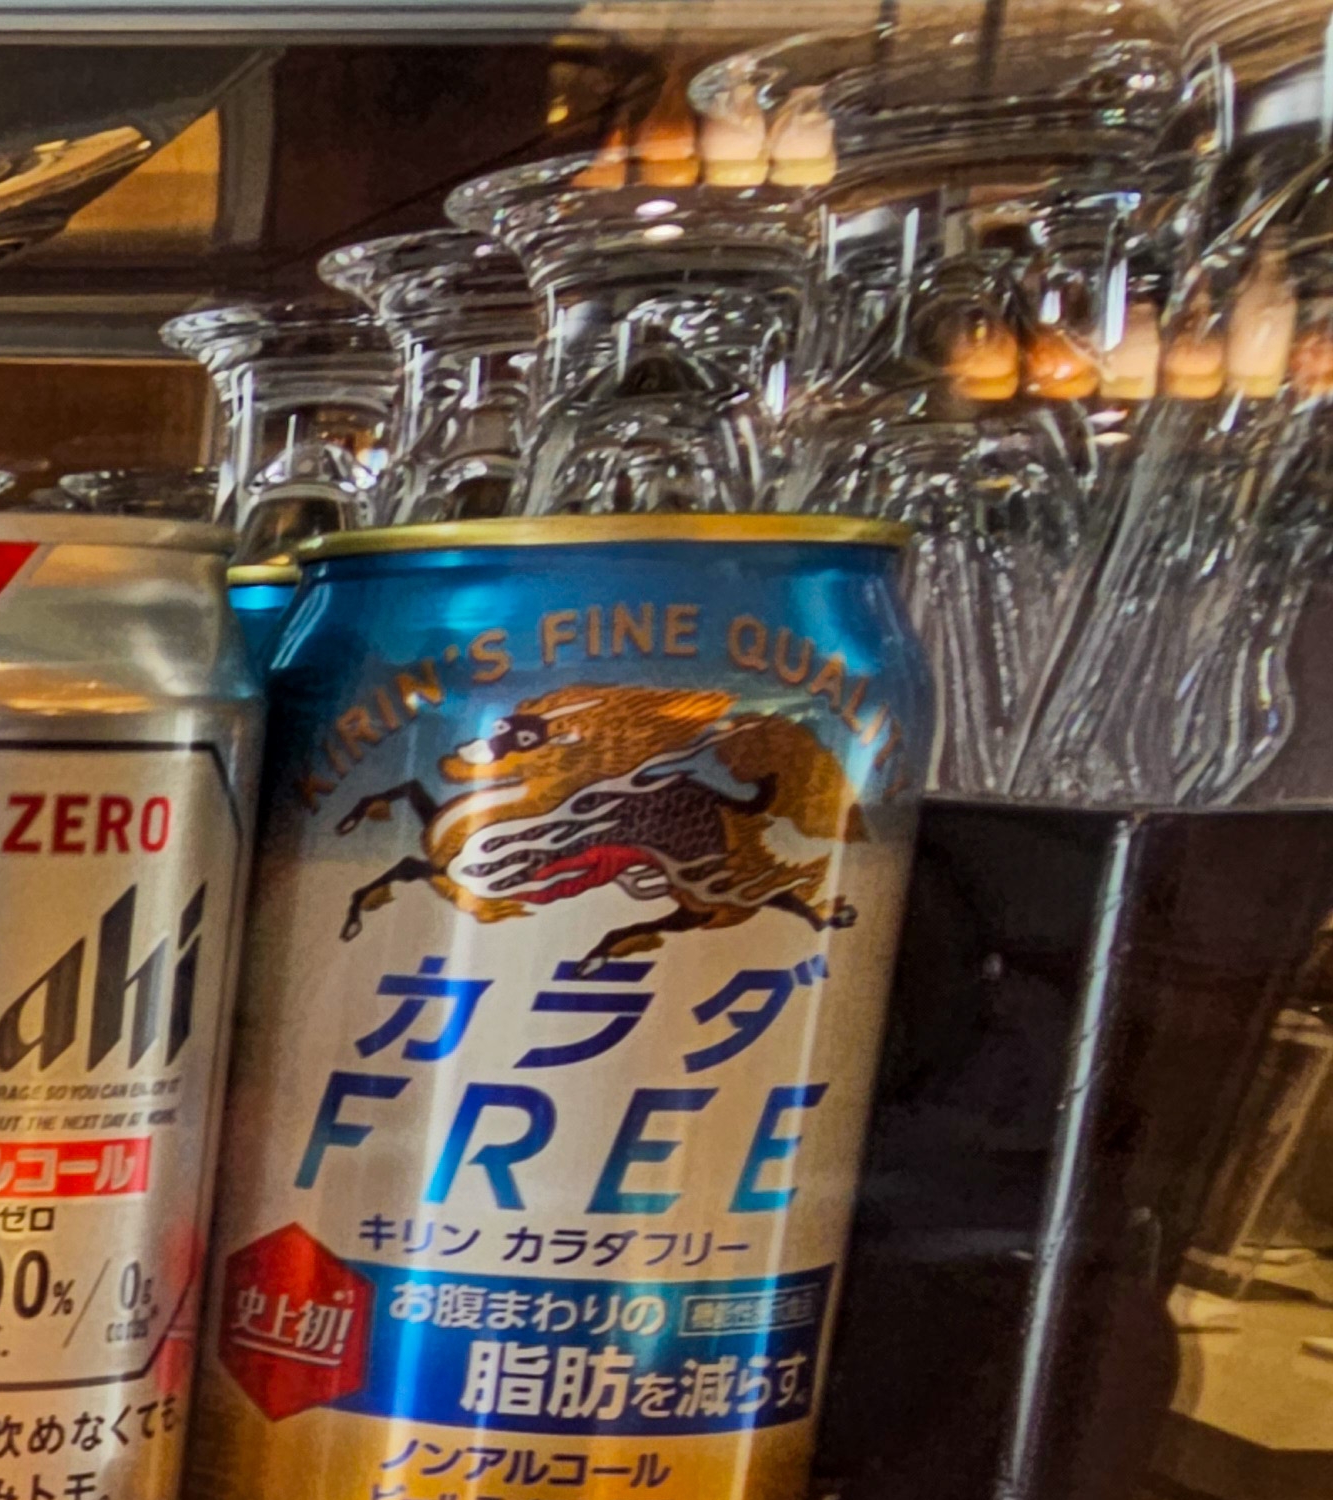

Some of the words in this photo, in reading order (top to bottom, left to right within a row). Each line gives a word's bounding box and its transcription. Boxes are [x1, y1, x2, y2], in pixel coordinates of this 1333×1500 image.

[291, 628, 513, 815] KIRIN'S
[540, 600, 701, 668] FINE
[727, 612, 906, 798] QUALI
[354, 953, 830, 1074] カラダ
[294, 1069, 830, 1215] FREE
[358, 1213, 482, 1257] キリン
[389, 1280, 666, 1336] お腹まわりの
[380, 1438, 672, 1490] ノンアルコール
